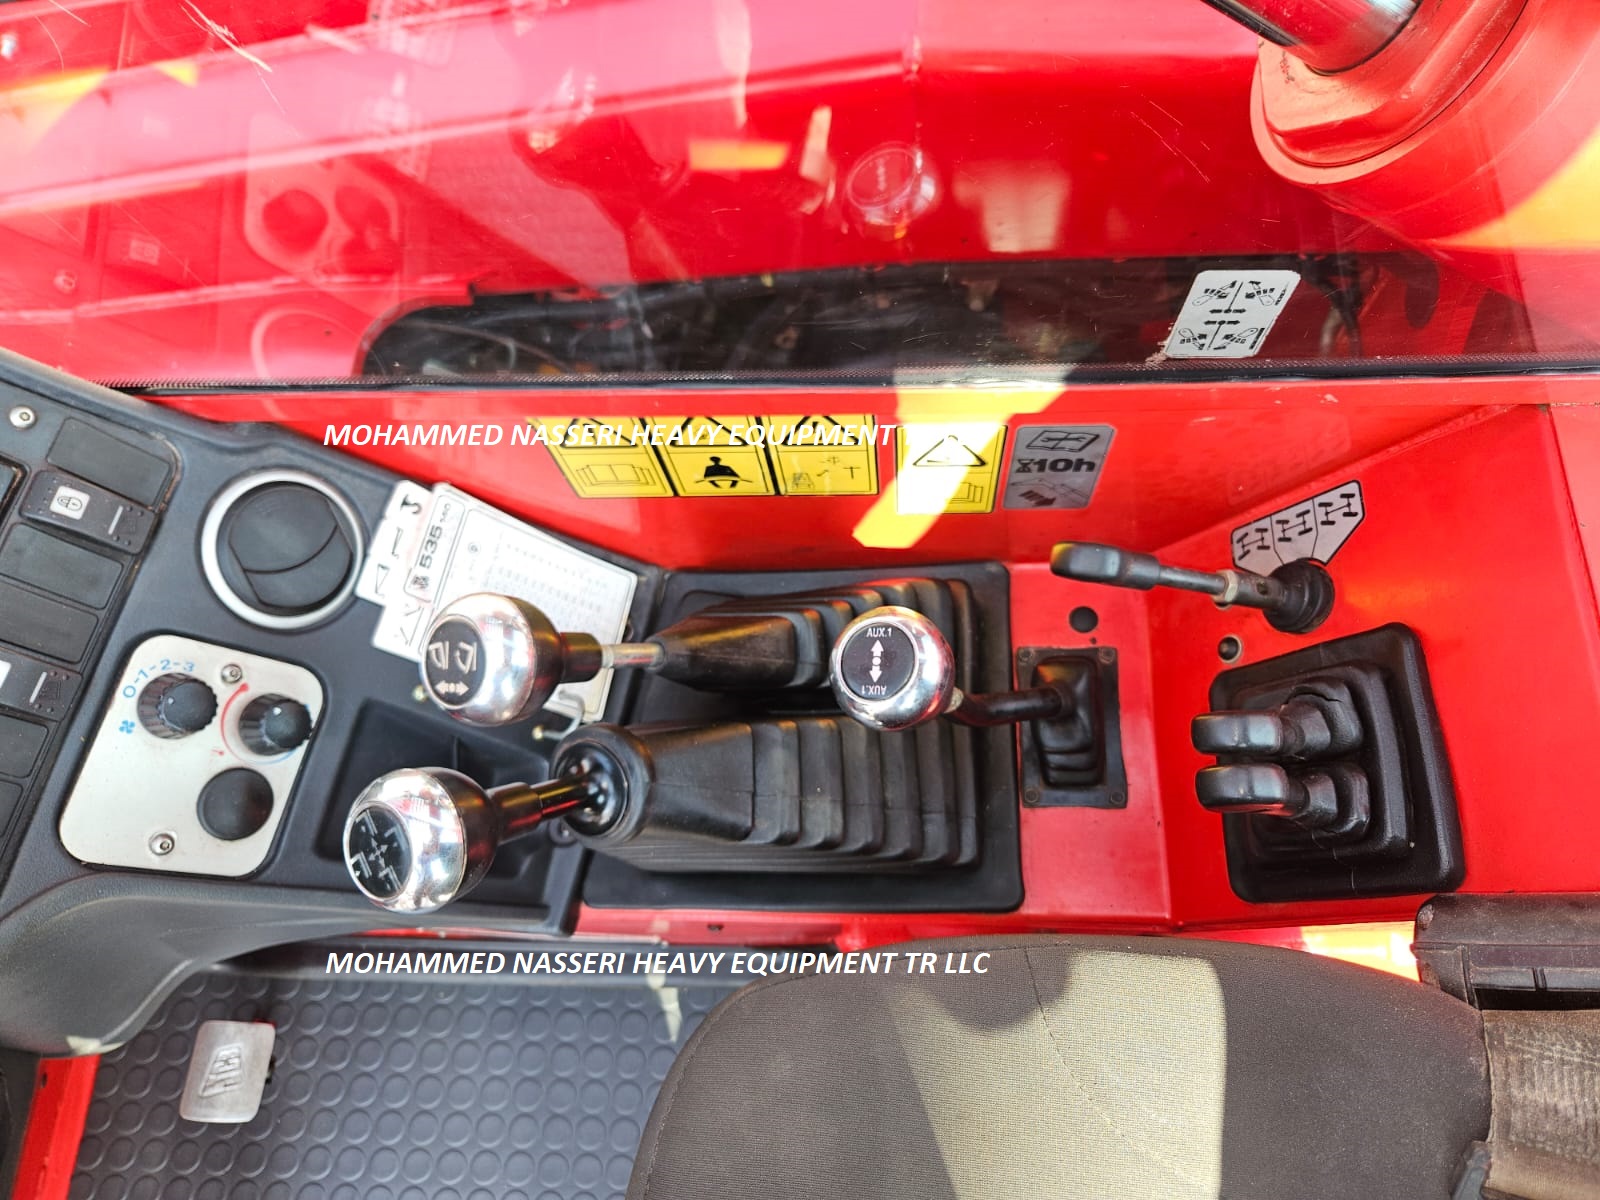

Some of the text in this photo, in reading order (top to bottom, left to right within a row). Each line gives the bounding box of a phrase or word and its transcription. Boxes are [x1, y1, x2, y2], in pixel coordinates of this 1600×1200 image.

[1033, 458, 1096, 473] 10h
[420, 525, 443, 569] 535
[866, 627, 893, 638] AUX.1
[861, 685, 887, 695] AUX.1
